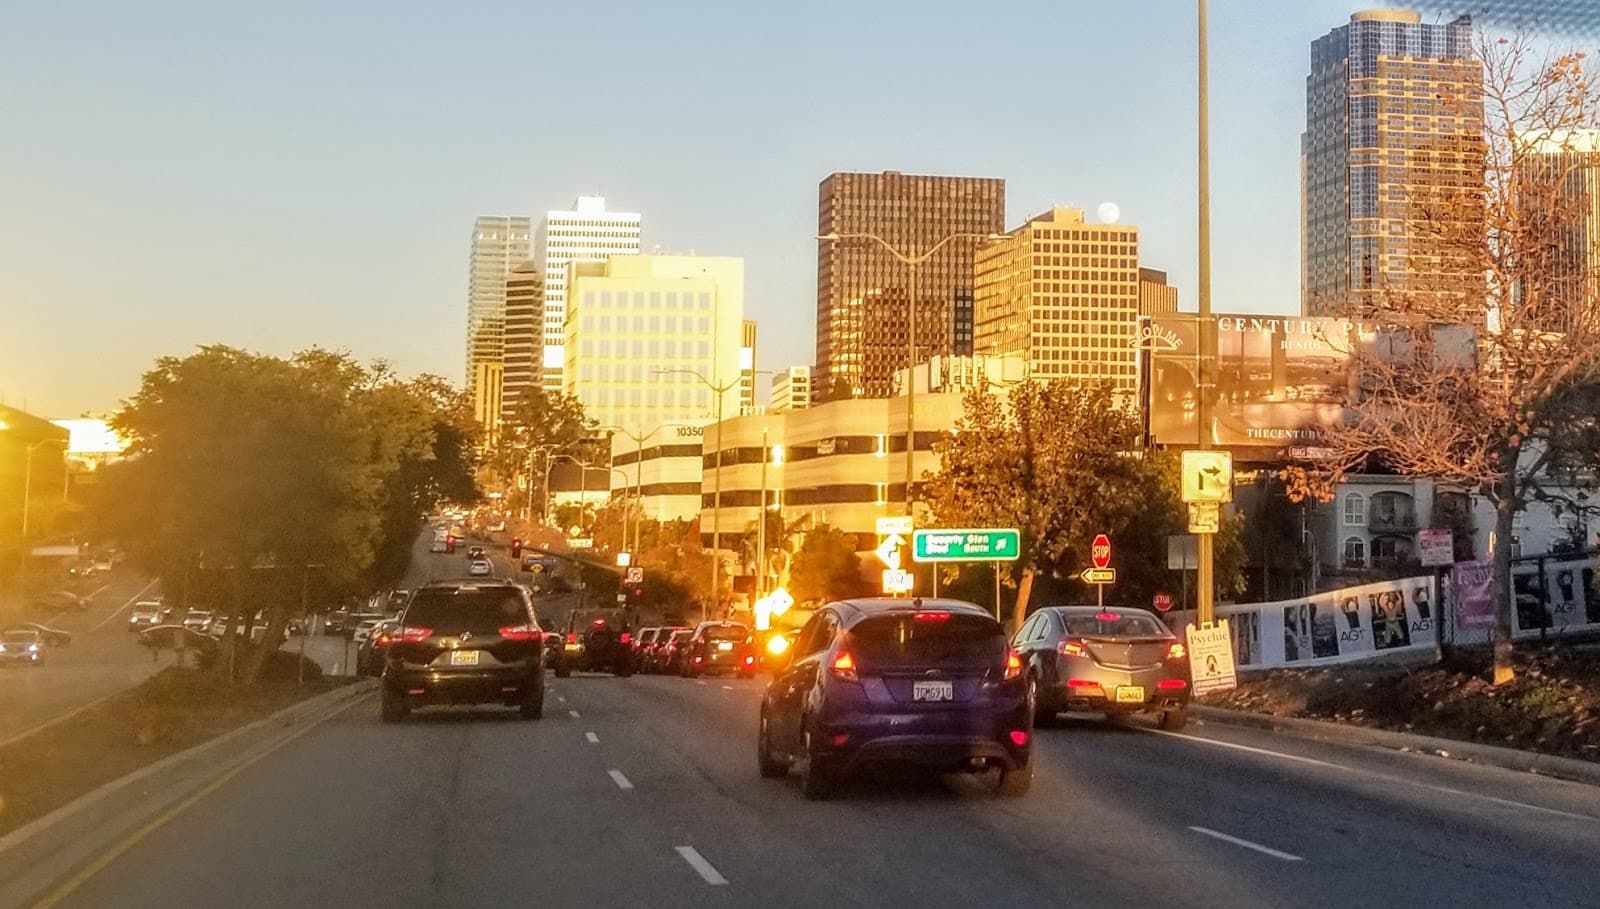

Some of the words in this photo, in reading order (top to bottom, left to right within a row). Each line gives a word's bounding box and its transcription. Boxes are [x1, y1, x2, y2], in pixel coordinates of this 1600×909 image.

[1218, 317, 1327, 335] CENTURY
[677, 426, 704, 436] 10350
[1094, 546, 1109, 558] STOP
[1190, 631, 1228, 646] Psychic
